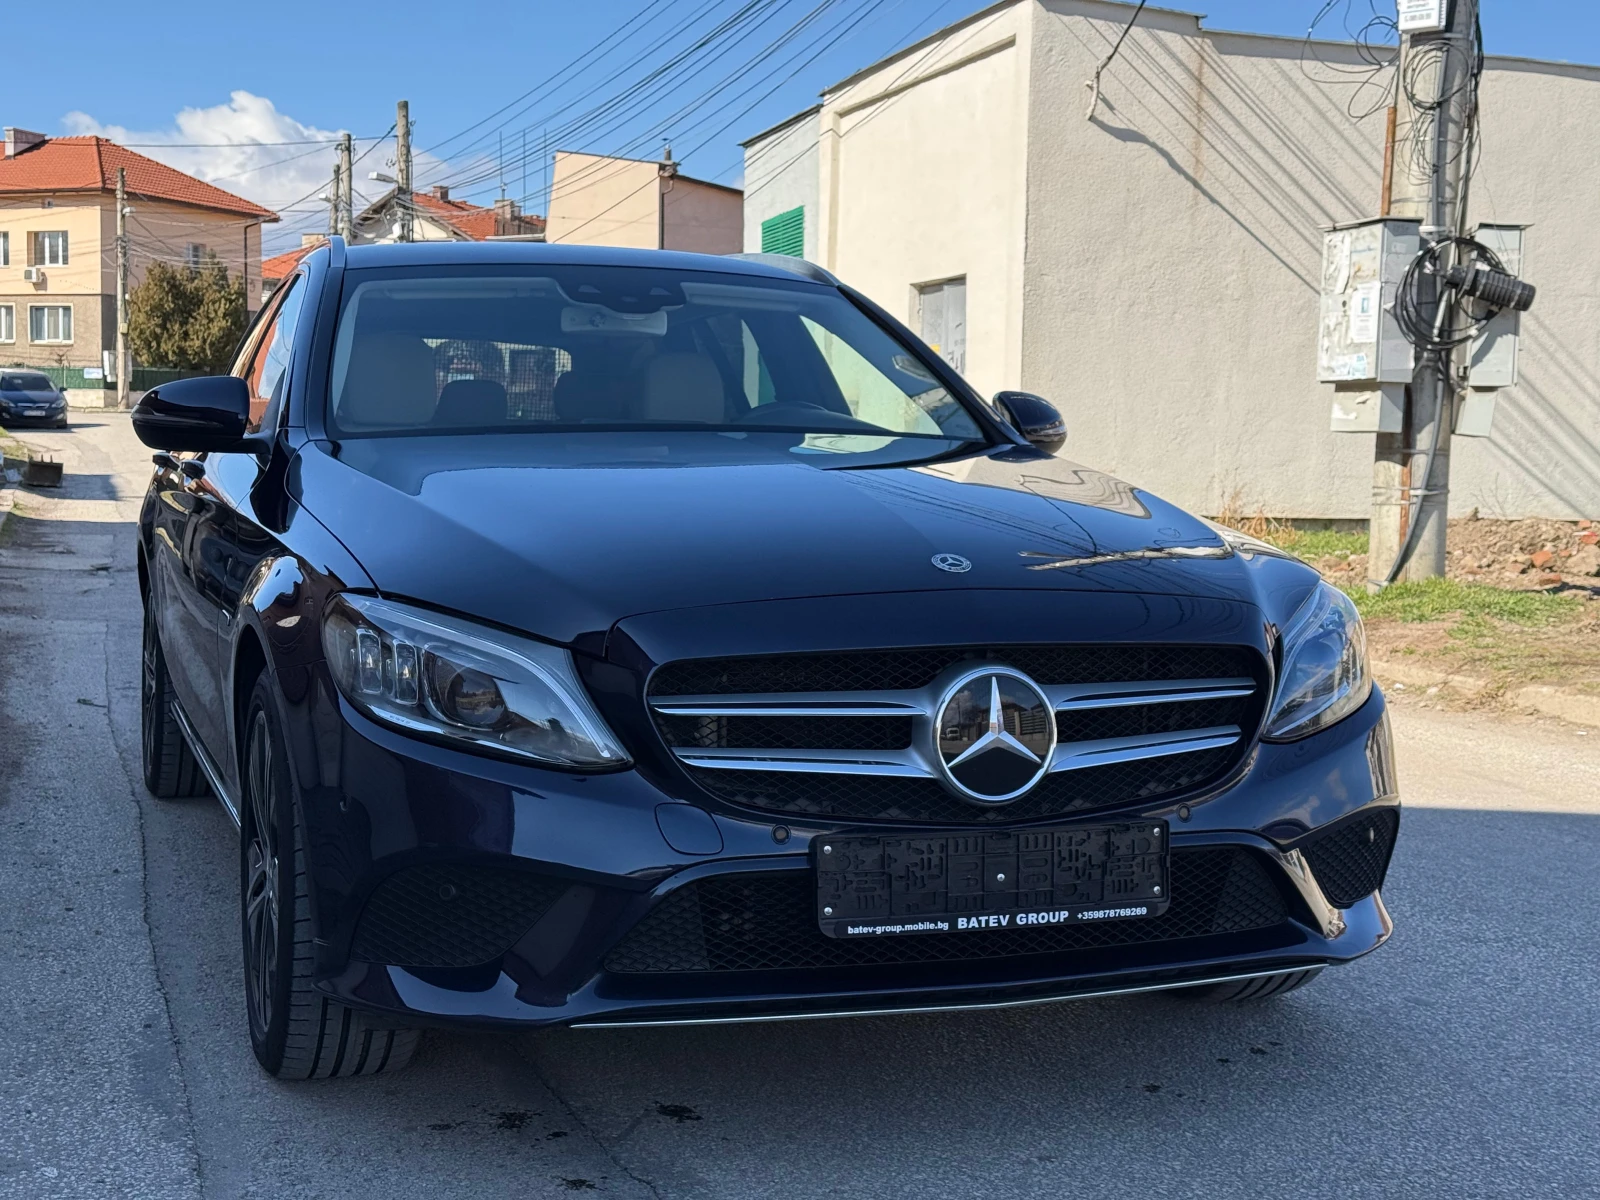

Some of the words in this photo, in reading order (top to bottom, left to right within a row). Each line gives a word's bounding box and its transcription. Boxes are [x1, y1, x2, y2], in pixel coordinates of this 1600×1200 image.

[848, 921, 949, 934] batev-group.mobile.bg
[957, 914, 1010, 929] BATEV
[1016, 910, 1069, 925] GROUP
[1077, 907, 1147, 919] +359878769269
